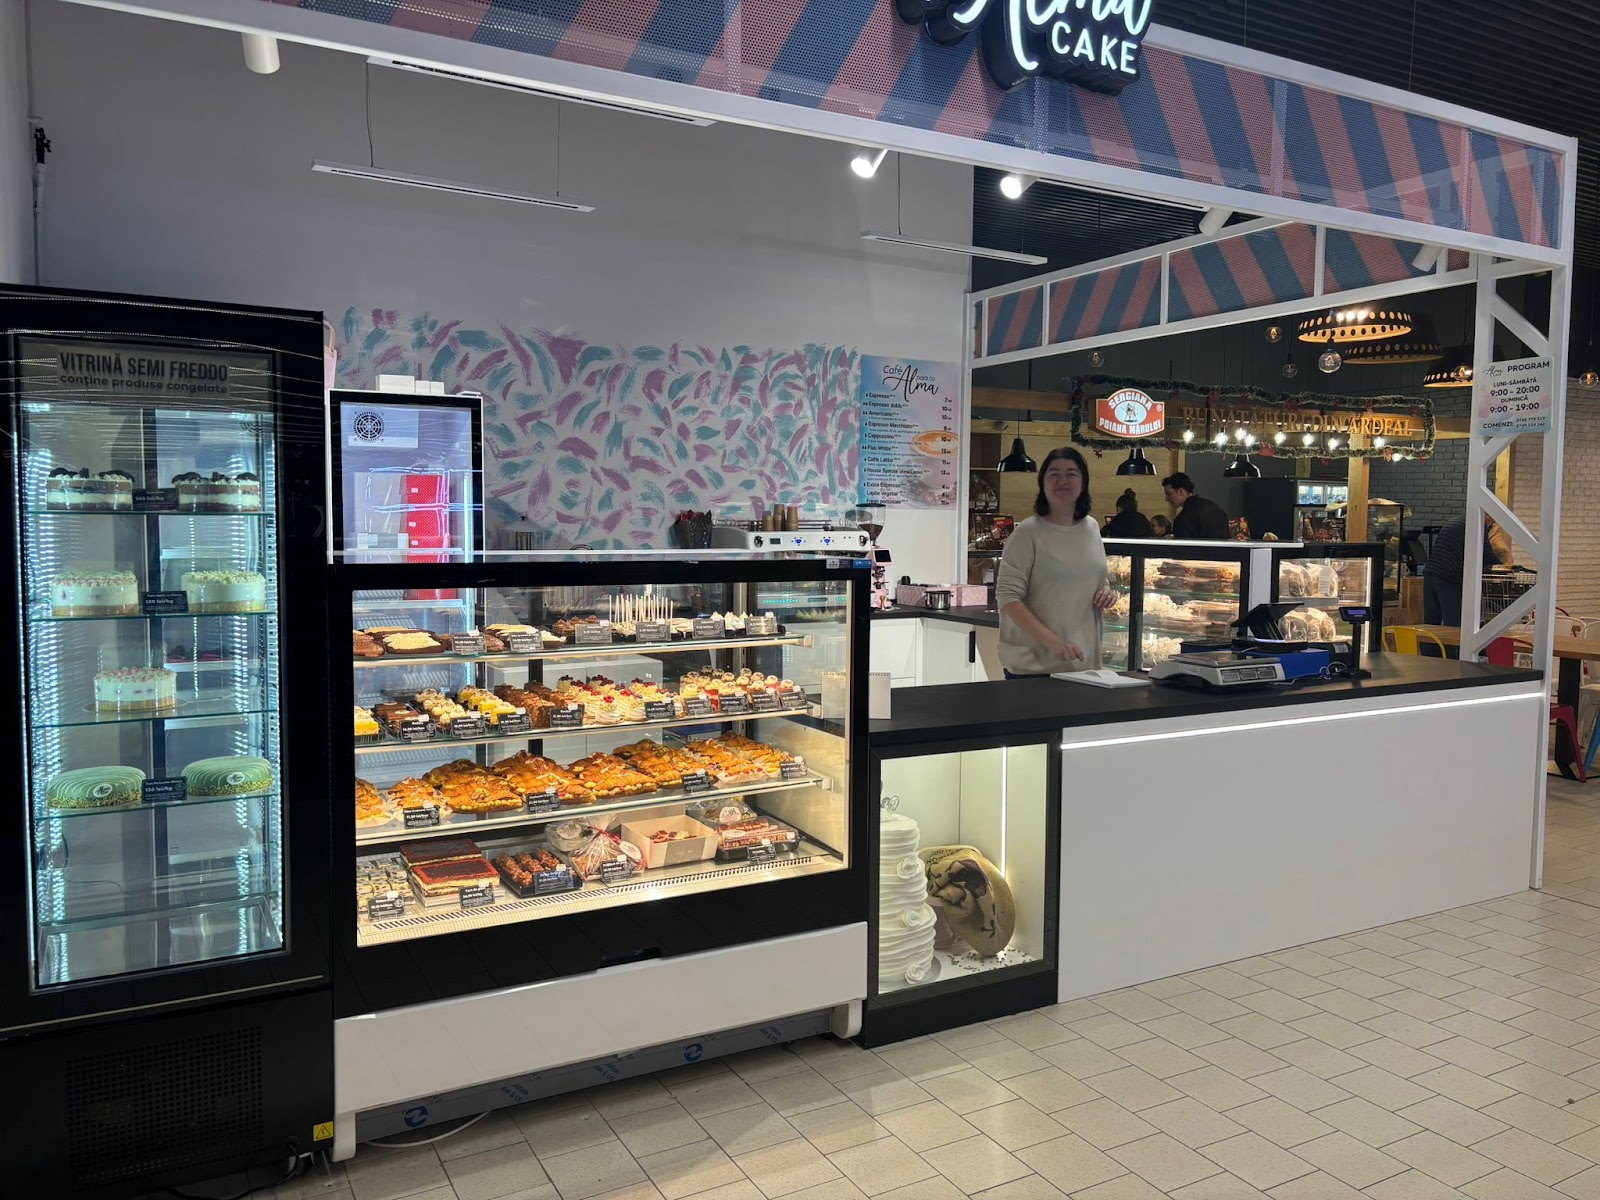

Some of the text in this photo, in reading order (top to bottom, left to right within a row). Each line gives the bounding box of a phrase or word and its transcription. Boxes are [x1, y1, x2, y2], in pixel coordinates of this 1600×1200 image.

[1051, 20, 1139, 75] CAKE
[59, 351, 228, 382] VITRINĂ SEMI FREDDO
[883, 364, 903, 375] Café
[1507, 361, 1550, 372] PROGRAM
[111, 377, 164, 389] produse
[166, 381, 229, 395] congelate
[883, 364, 940, 403] Alma
[1490, 388, 1509, 397] 9:00
[1515, 385, 1540, 395] 20:00
[1108, 391, 1153, 411] SERGIANA
[1489, 405, 1508, 414] 9:00
[1515, 402, 1540, 412] 19:00
[1099, 417, 1127, 434] POIANA
[1347, 416, 1414, 437] ARDEAL
